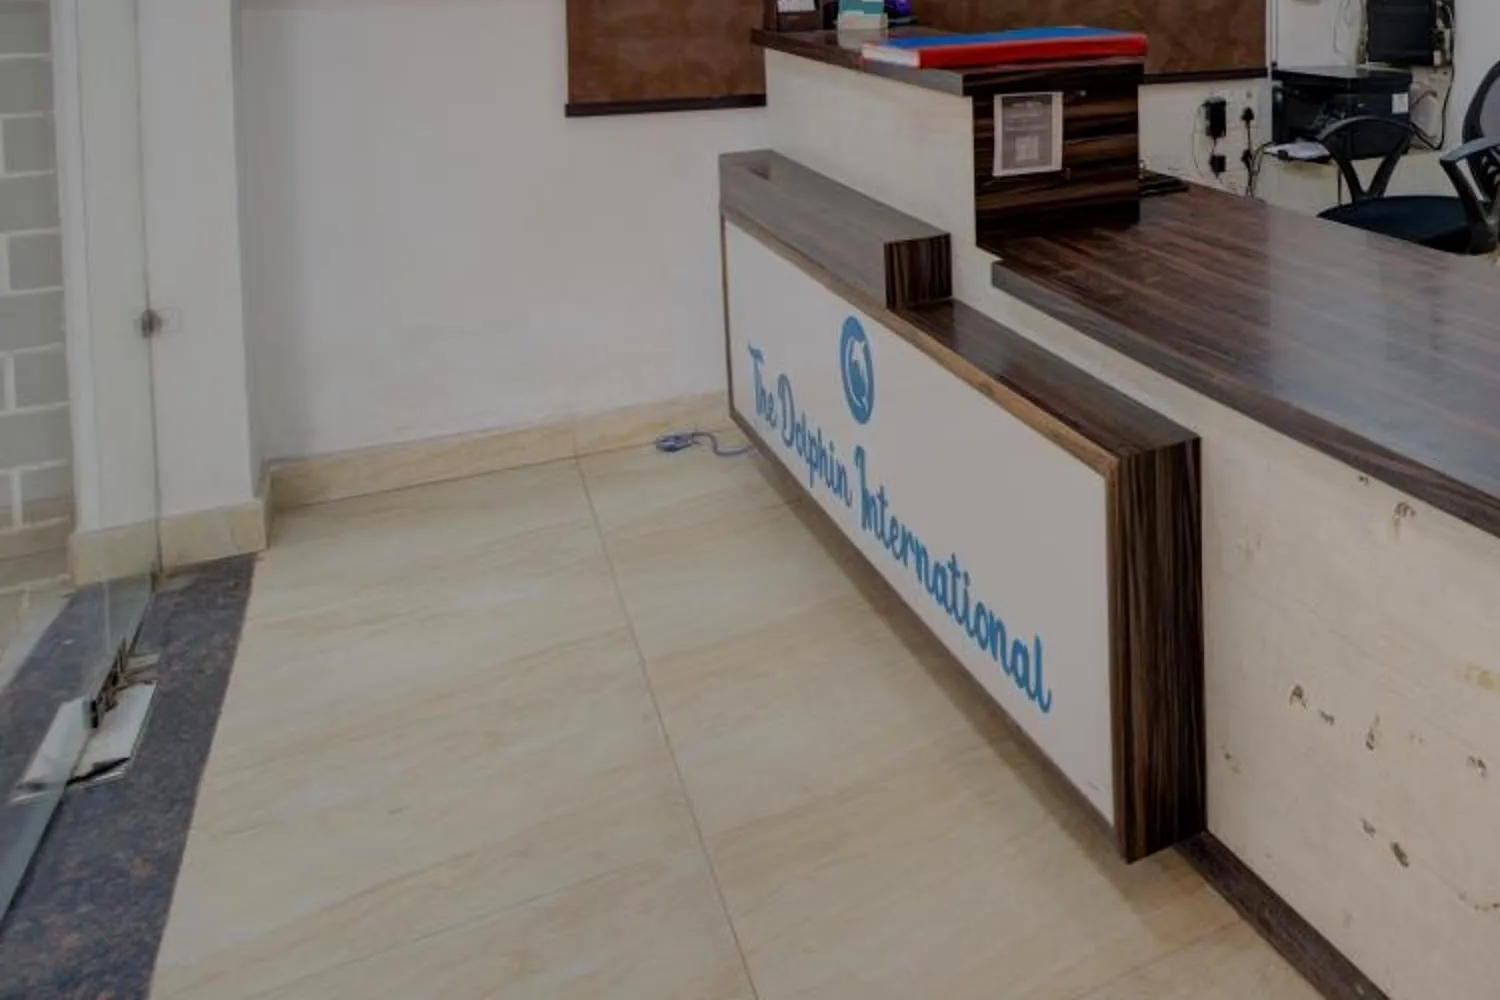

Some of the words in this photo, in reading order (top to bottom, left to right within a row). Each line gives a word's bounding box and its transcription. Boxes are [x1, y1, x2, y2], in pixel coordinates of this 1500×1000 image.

[748, 342, 777, 428] The
[778, 373, 852, 507] Dolphin
[854, 445, 1052, 713] International
